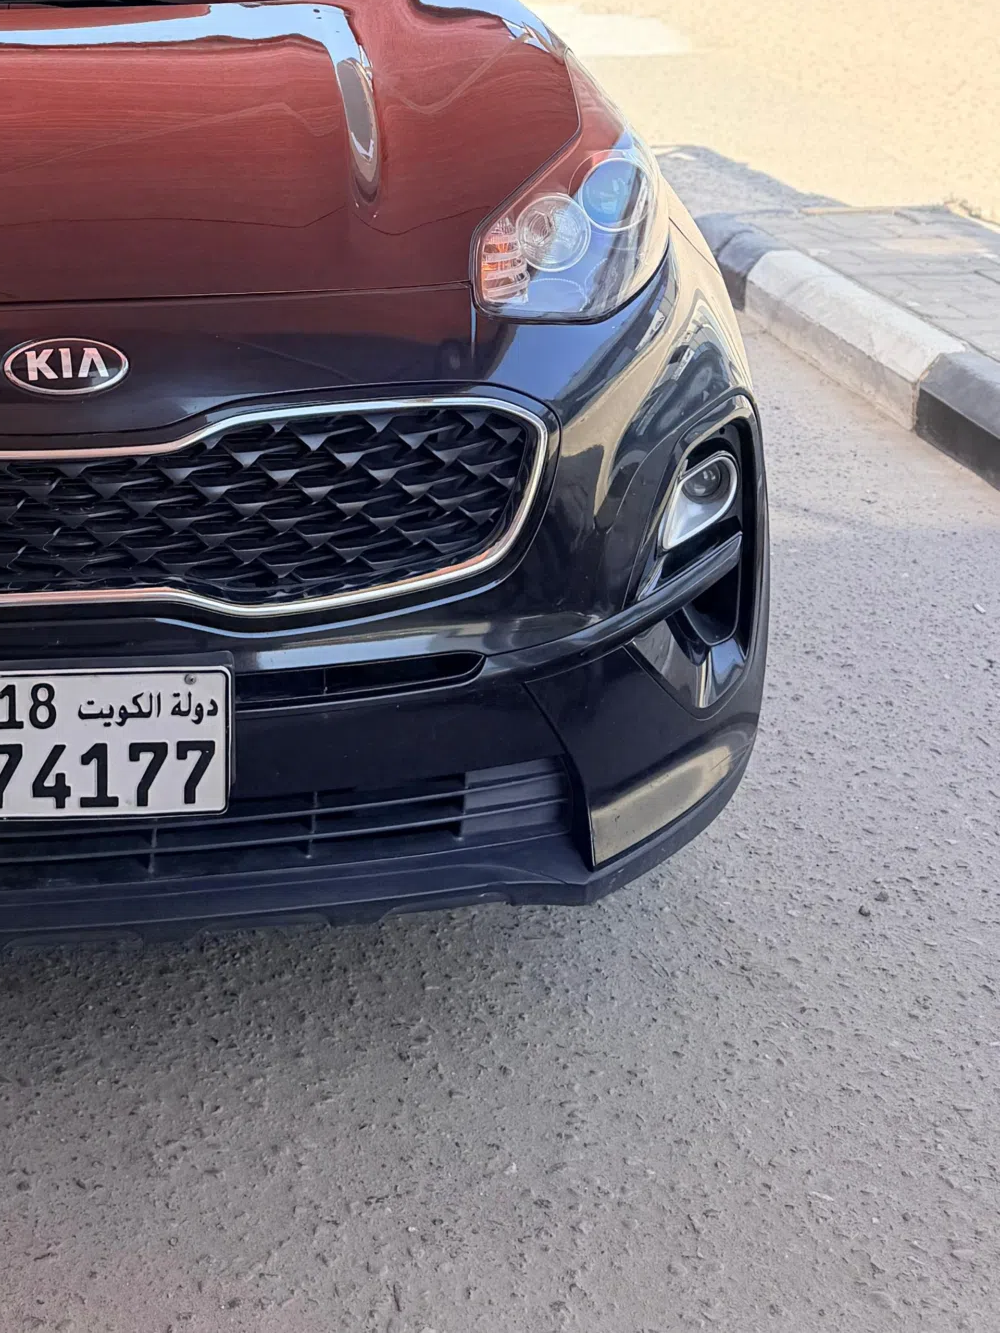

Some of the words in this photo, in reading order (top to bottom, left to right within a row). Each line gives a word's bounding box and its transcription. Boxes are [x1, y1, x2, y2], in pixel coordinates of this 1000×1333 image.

[25, 347, 110, 381] KIA
[77, 691, 162, 728] الكويت
[170, 690, 219, 725] دولة
